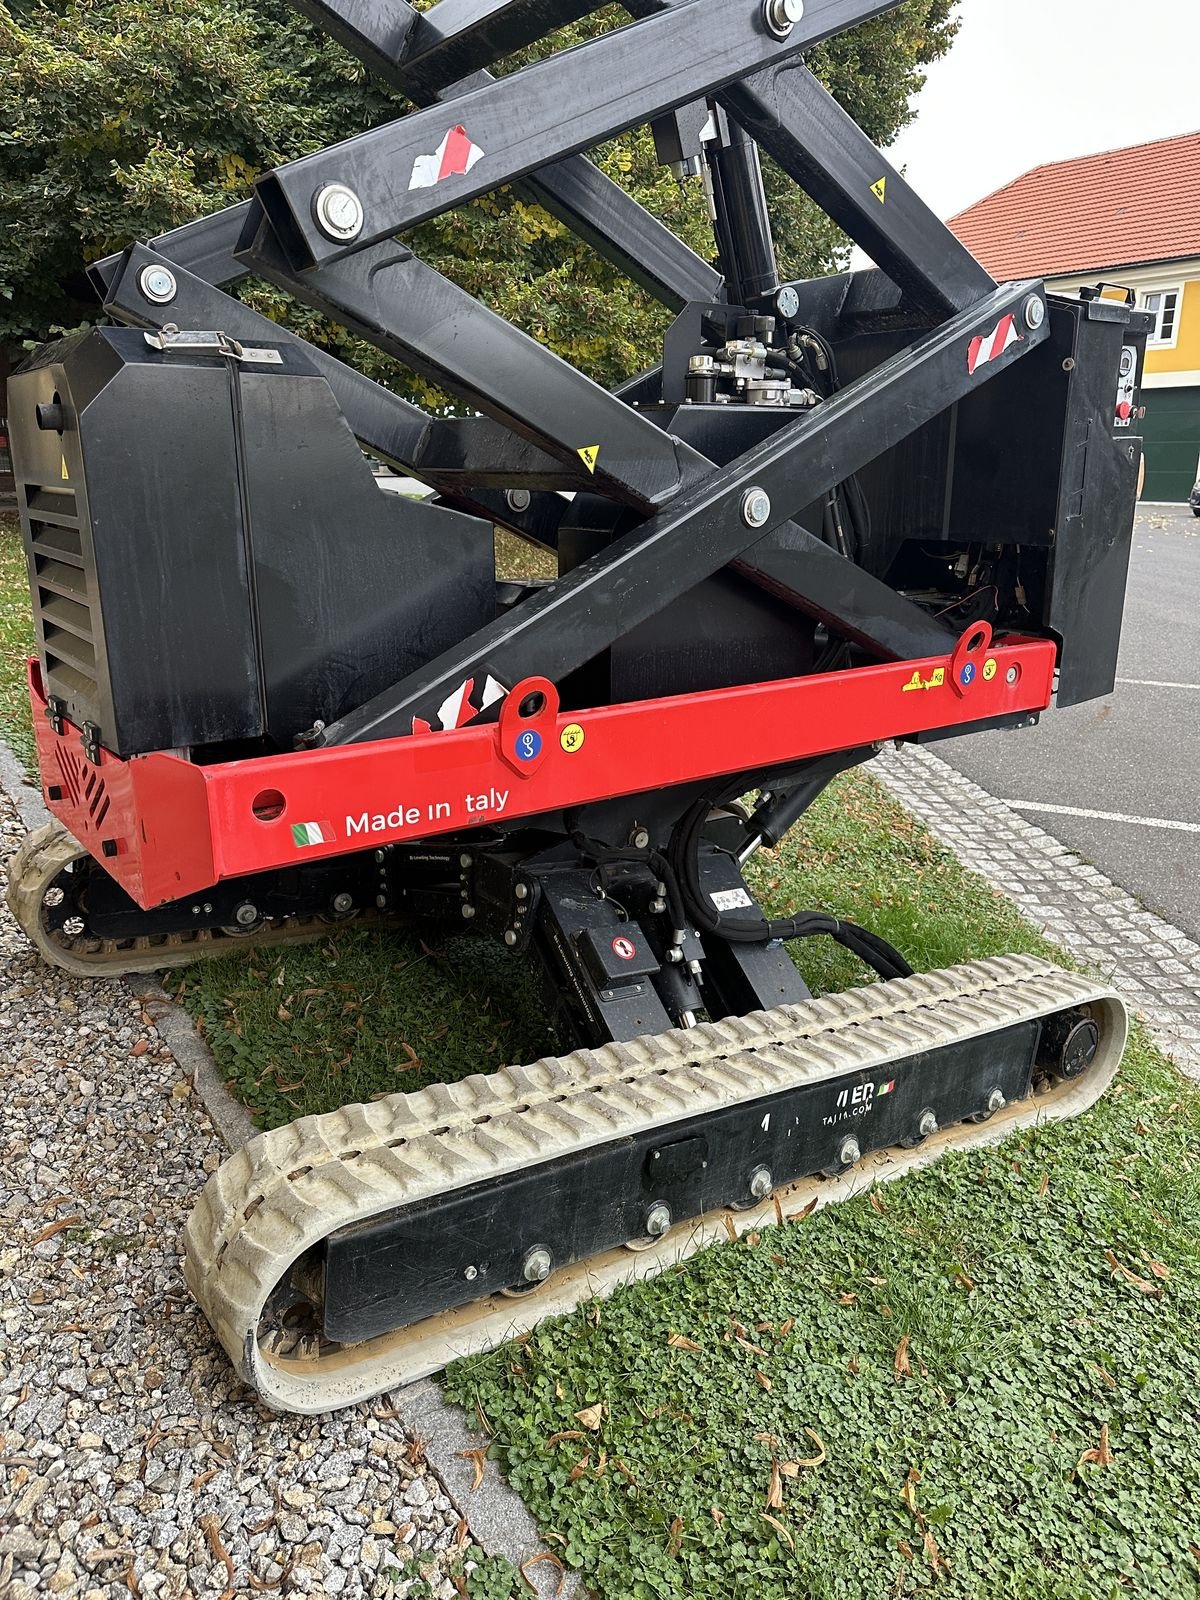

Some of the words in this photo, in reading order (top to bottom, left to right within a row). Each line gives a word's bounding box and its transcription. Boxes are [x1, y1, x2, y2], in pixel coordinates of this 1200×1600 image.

[345, 804, 421, 837] Made
[428, 801, 451, 821] in
[465, 787, 509, 813] taly
